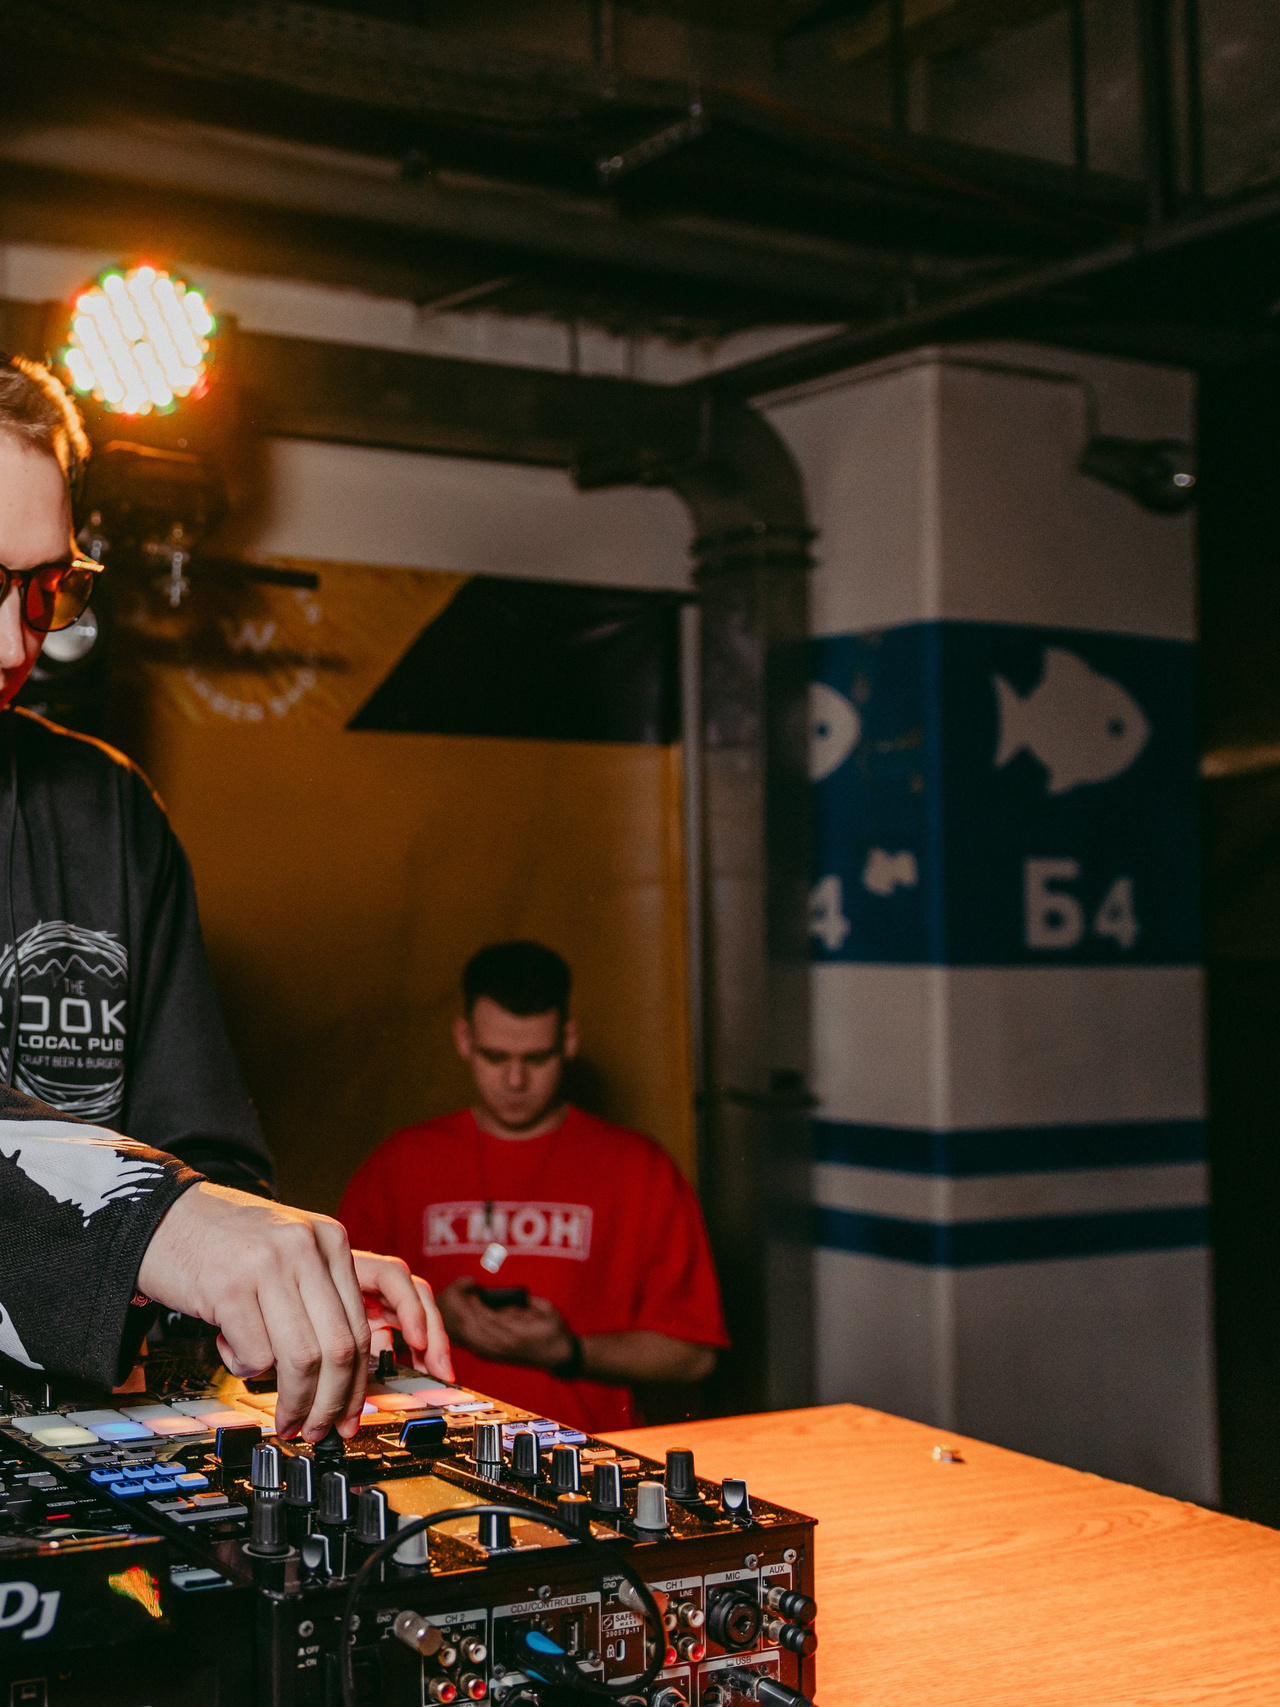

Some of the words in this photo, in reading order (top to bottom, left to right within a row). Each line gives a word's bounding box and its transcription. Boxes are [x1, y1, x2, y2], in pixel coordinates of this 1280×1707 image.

[1023, 857, 1140, 951] Б4
[64, 978, 87, 996] THE
[18, 1034, 82, 1051] LOCAL
[88, 1037, 125, 1052] PUB
[21, 1053, 50, 1068] CRAFT
[52, 1055, 75, 1069] BEER
[769, 1564, 785, 1575] AUX
[725, 1571, 741, 1581] MIC
[603, 1582, 617, 1590] GND
[665, 1581, 678, 1590] CH
[679, 1580, 683, 1588] 1
[680, 1589, 694, 1598] LINE
[510, 1594, 587, 1615] CDJ/CONTROLLER
[445, 1615, 459, 1625] CH
[459, 1613, 466, 1622] 2
[462, 1623, 477, 1632] LINE
[306, 1645, 320, 1655] OFF
[306, 1658, 317, 1668] ON
[735, 1656, 752, 1667] USB
